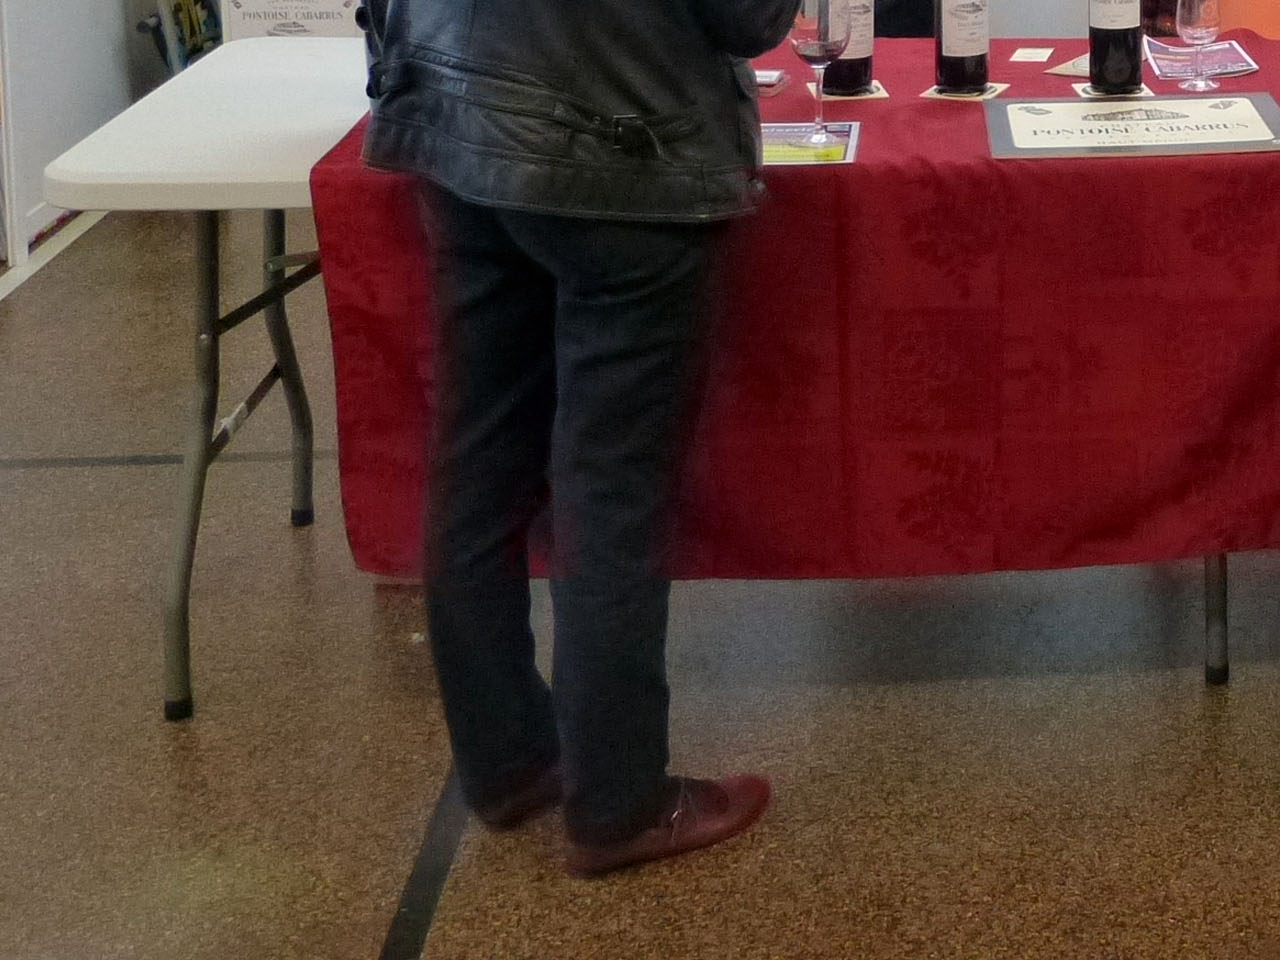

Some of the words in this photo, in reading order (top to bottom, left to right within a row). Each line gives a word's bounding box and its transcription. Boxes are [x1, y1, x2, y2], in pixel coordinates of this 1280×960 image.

[242, 12, 290, 22] PONTOISE
[295, 11, 343, 21] CABARRUS
[1031, 127, 1132, 136] PONTOISE
[1143, 122, 1250, 134] CABARRUS
